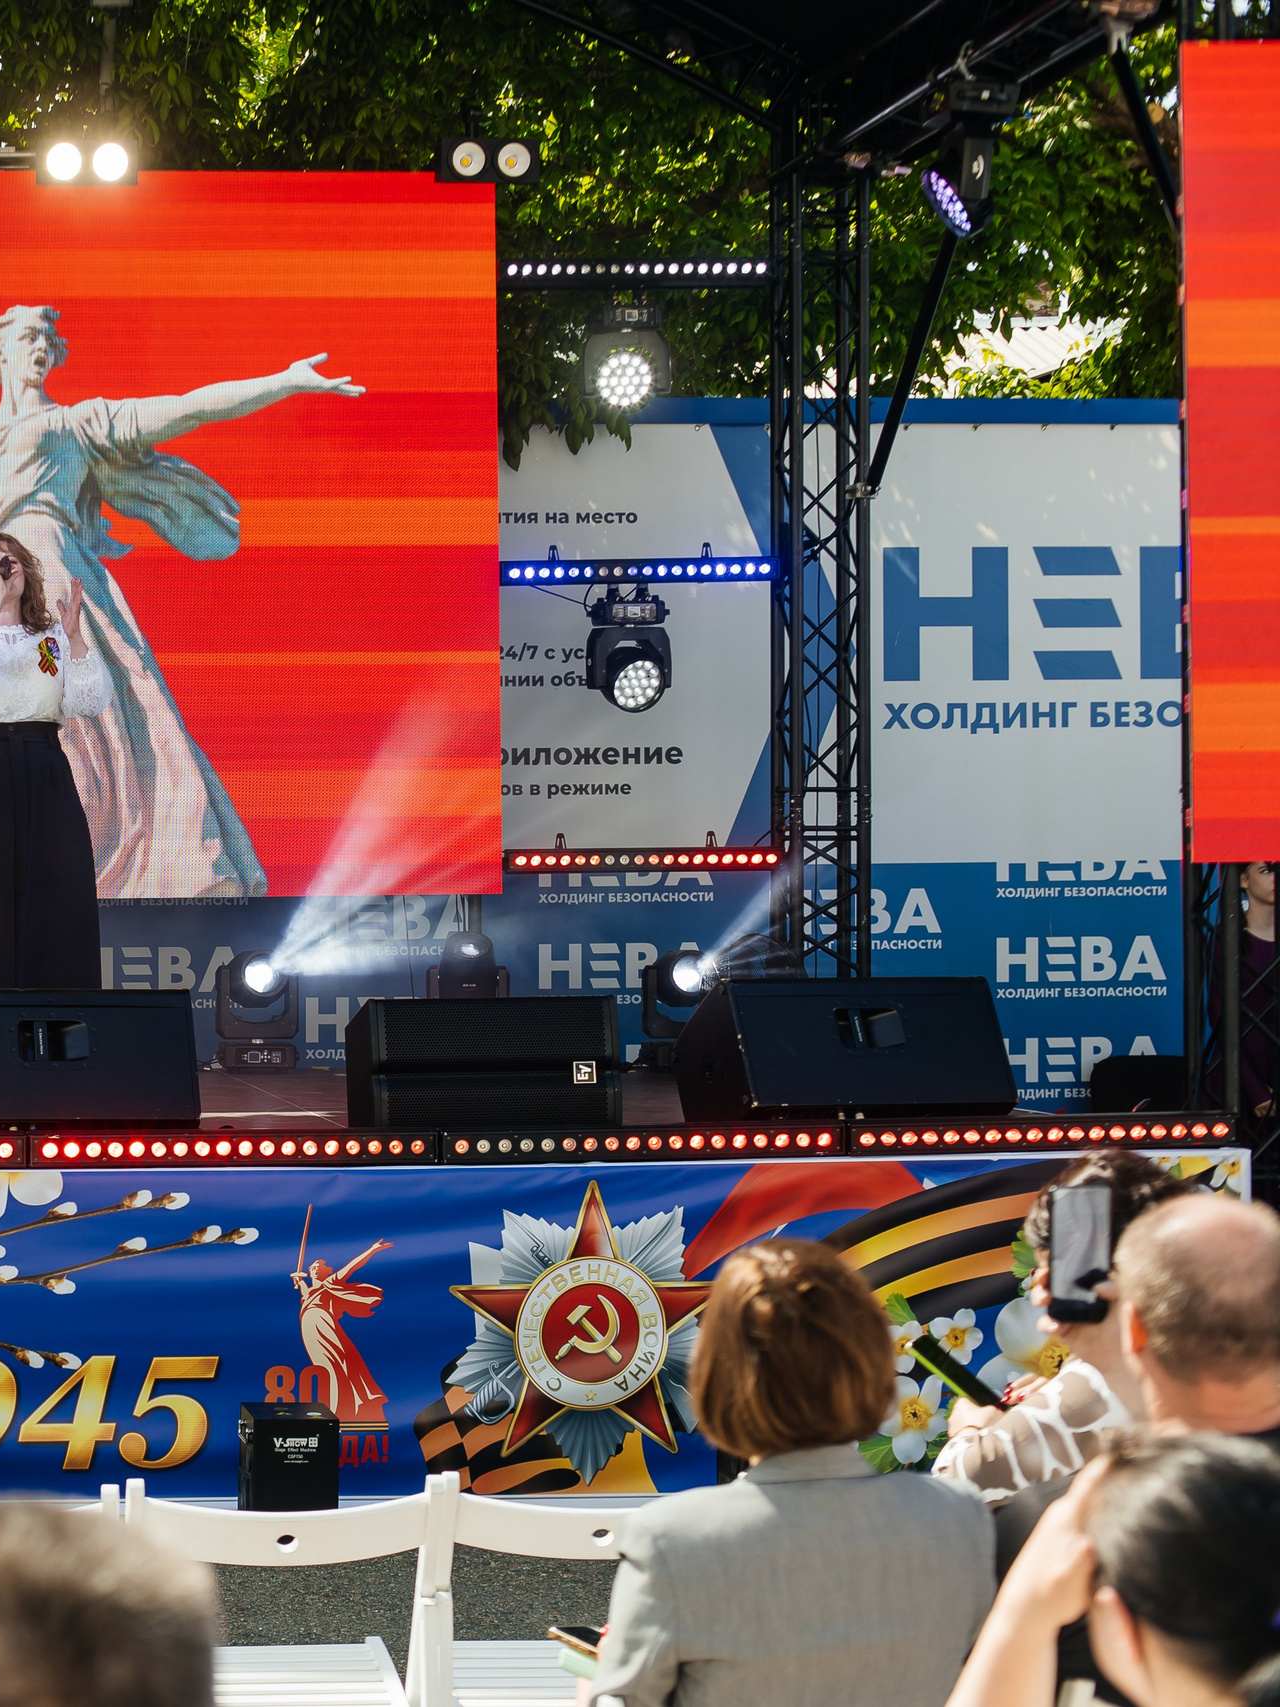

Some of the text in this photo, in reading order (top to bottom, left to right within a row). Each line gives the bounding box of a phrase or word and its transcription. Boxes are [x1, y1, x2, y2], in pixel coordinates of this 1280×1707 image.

[499, 511, 638, 524] тия на место
[544, 648, 556, 660] с
[561, 648, 586, 663] ус
[500, 675, 544, 687] нии
[882, 700, 1182, 734] ХОЛДИНГ БЕЗО
[530, 784, 541, 796] в
[547, 783, 632, 799] режиме
[538, 892, 714, 905] ХОЛДИНГ БЕЗОПАСНОСТИ
[996, 886, 1167, 899] ХОЛДИНГ БЕЗОПАСНОСТИ
[872, 939, 942, 950] ПАСНОСТИ
[538, 942, 700, 990] НЕВ
[996, 935, 1167, 983] НЕВА
[996, 986, 1167, 999] ХОЛДИНГ БЕЗОПАСНОСТИ
[523, 1263, 651, 1392] ОТЕЧЕСТВЕННАЯ
